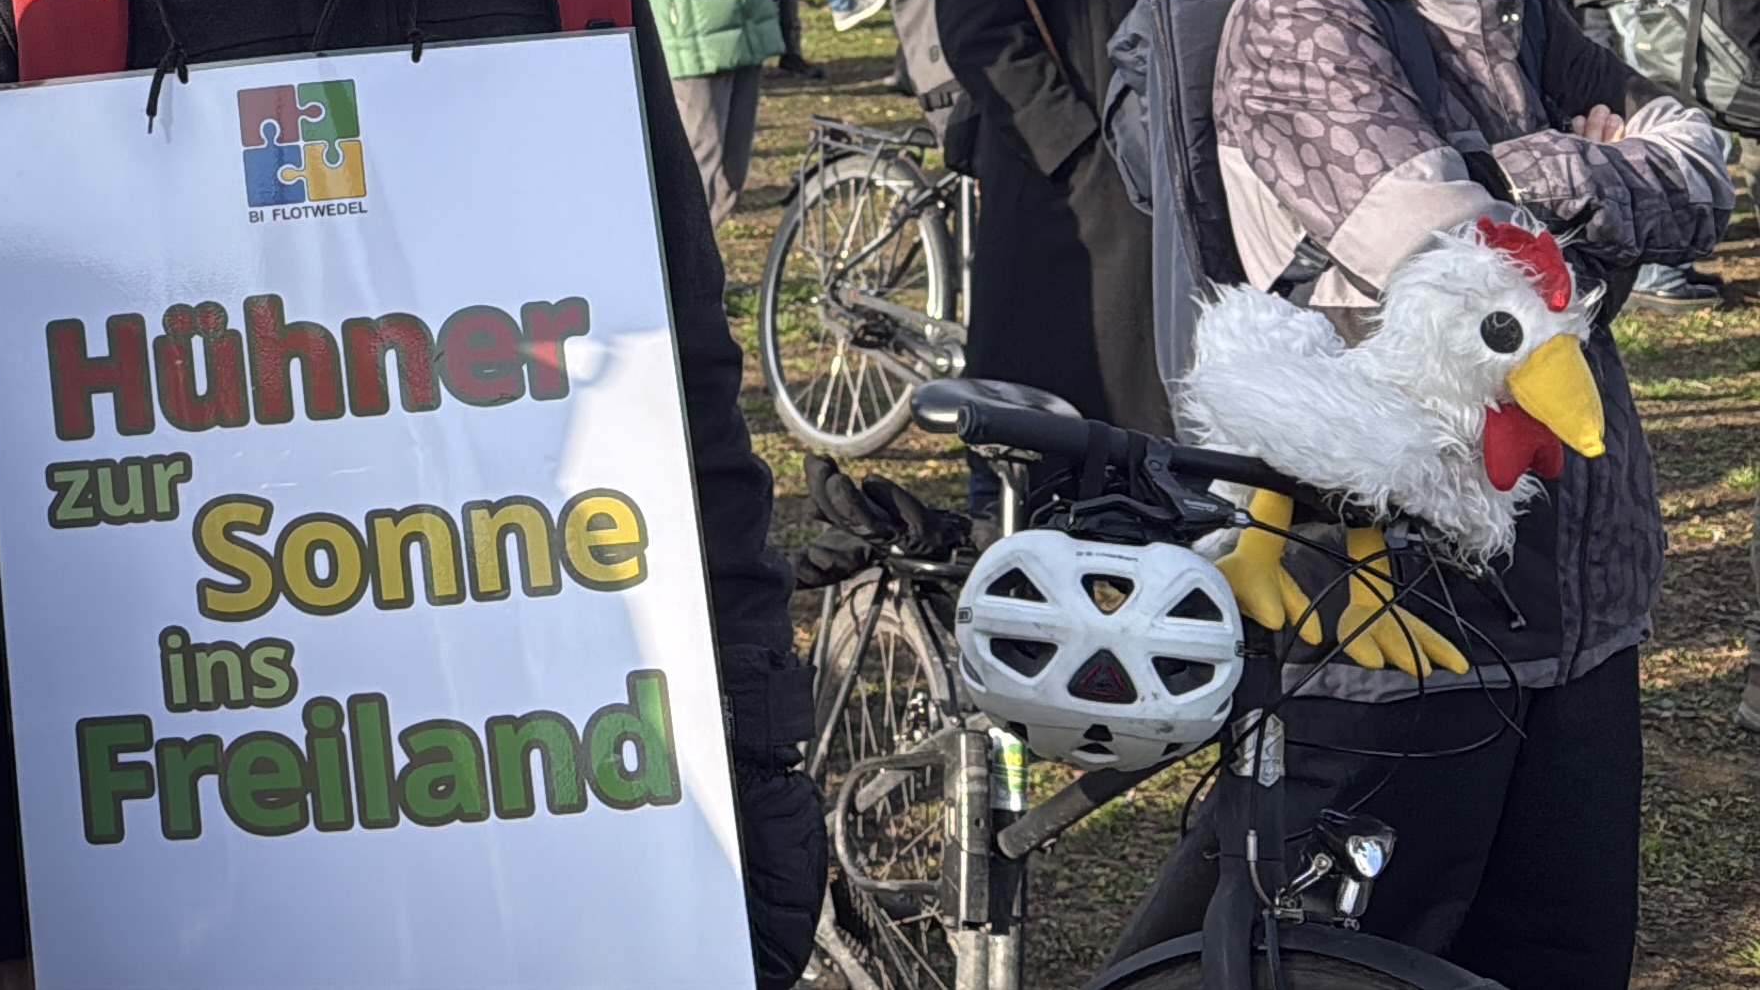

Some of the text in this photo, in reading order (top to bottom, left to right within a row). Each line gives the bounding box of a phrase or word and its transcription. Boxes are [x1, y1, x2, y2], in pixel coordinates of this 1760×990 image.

[248, 201, 369, 224] BI FLOTWEDEL
[45, 293, 590, 441] Hühner
[45, 452, 193, 530] zur
[192, 487, 649, 623] Sonne
[158, 625, 298, 713] ins
[74, 668, 683, 846] Freiland
